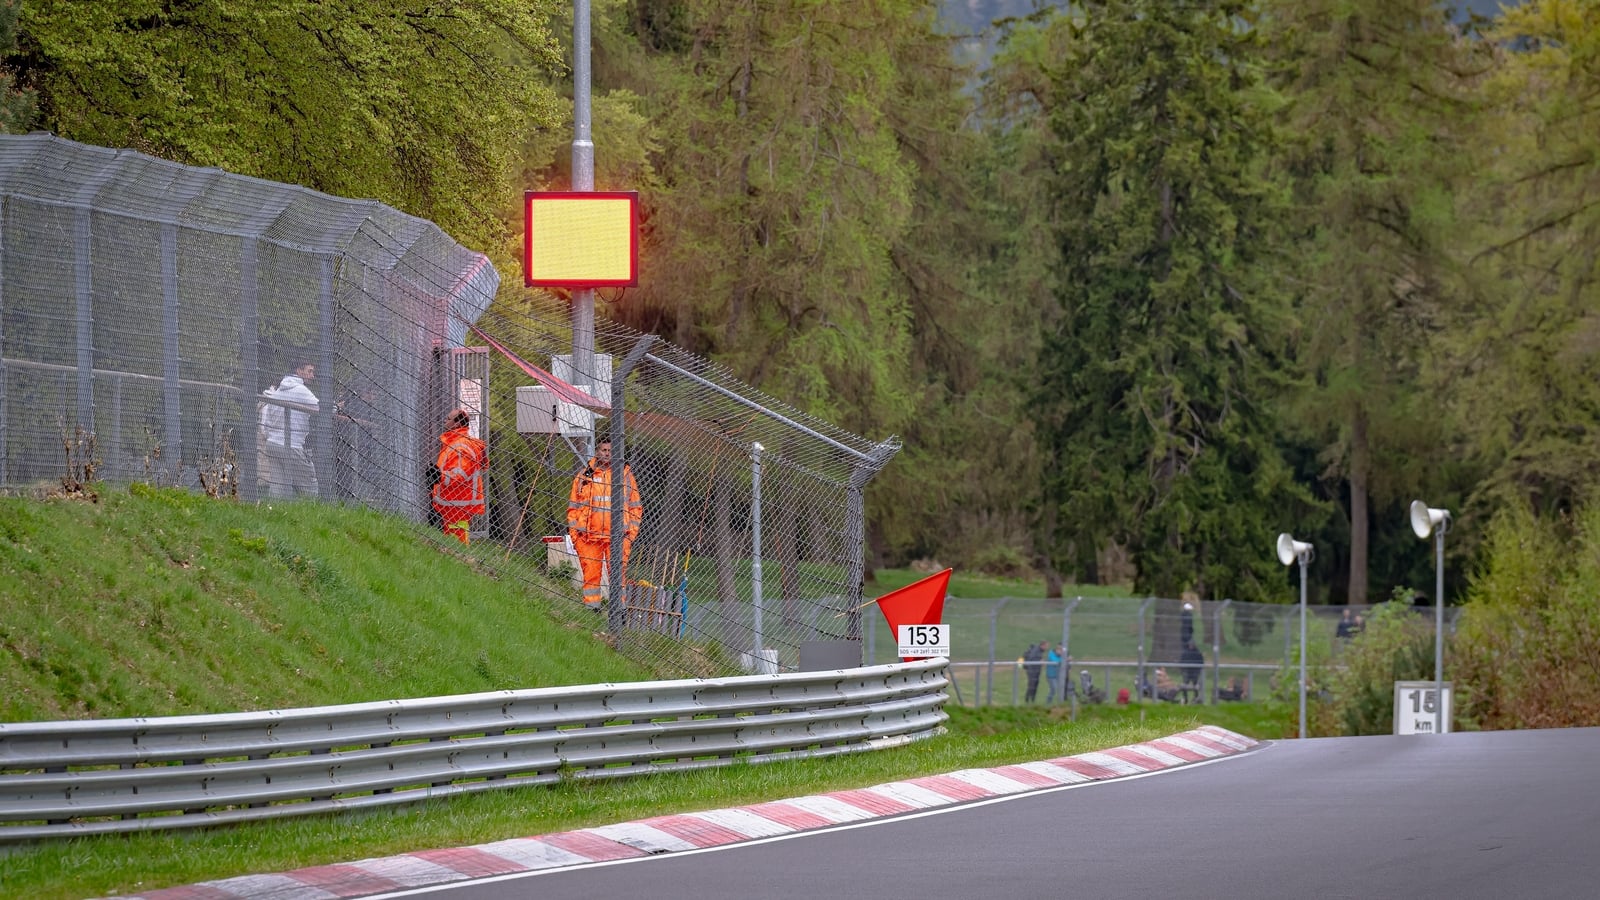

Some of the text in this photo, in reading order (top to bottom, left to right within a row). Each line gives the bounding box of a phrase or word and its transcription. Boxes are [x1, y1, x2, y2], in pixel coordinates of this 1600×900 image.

[908, 626, 940, 645] 153
[1408, 690, 1438, 713] 15
[1414, 718, 1432, 731] km
